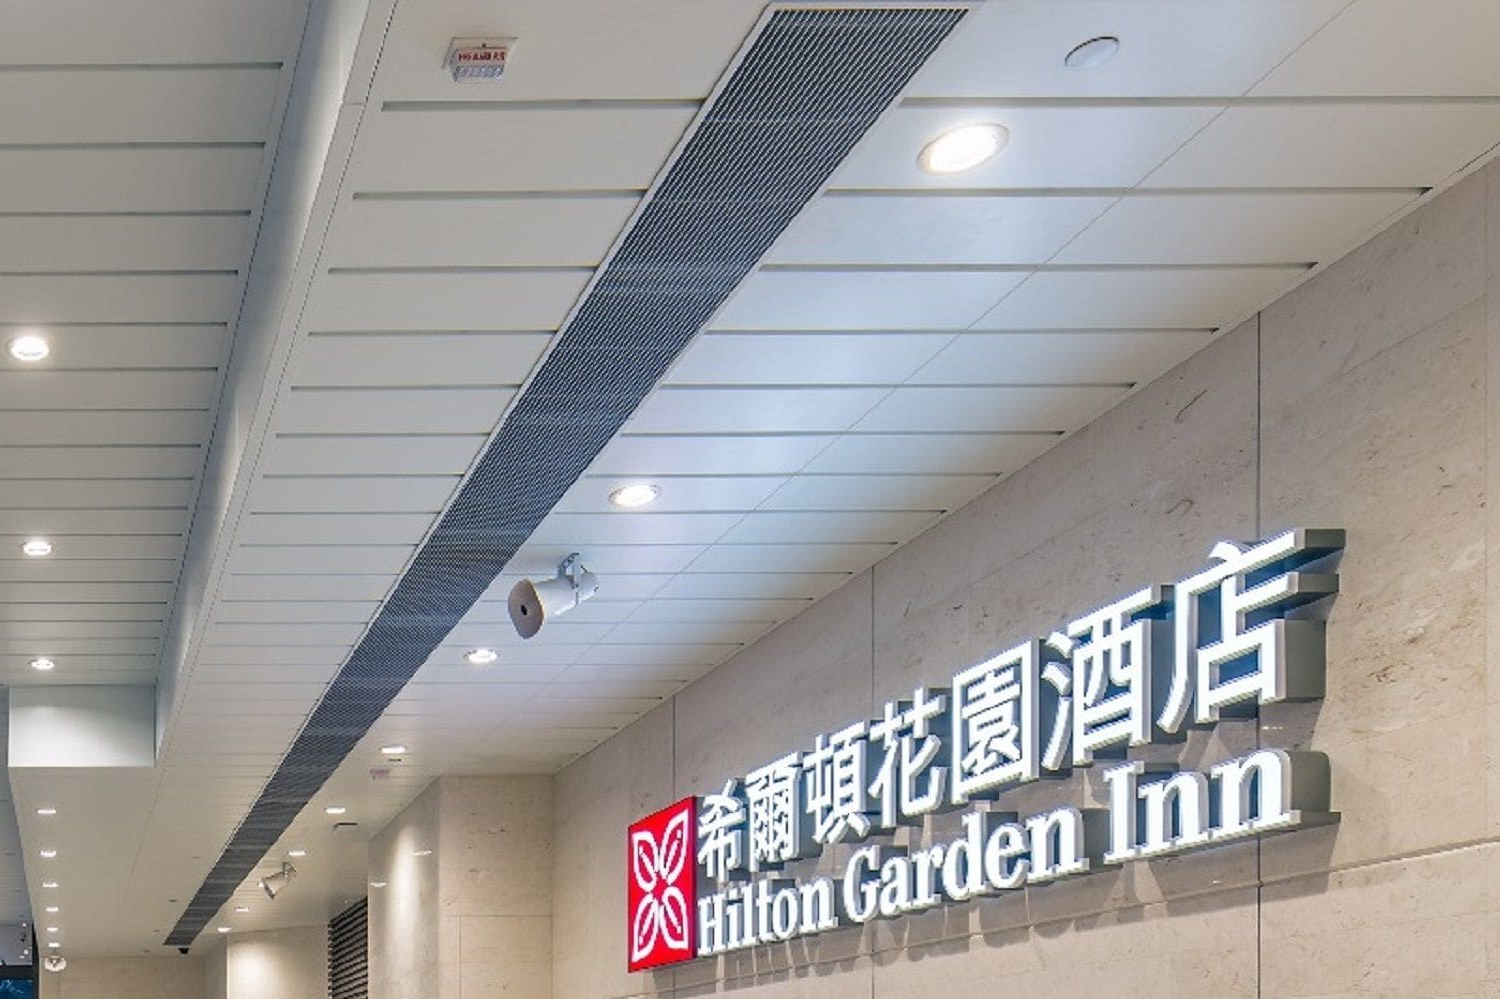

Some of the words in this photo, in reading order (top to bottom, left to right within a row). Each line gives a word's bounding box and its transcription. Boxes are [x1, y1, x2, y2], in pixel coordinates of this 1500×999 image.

[697, 528, 1312, 878] 希爾頓花園酒店
[697, 876, 840, 957] Hilton
[843, 806, 1090, 923] Garden
[1102, 748, 1302, 865] Inn
